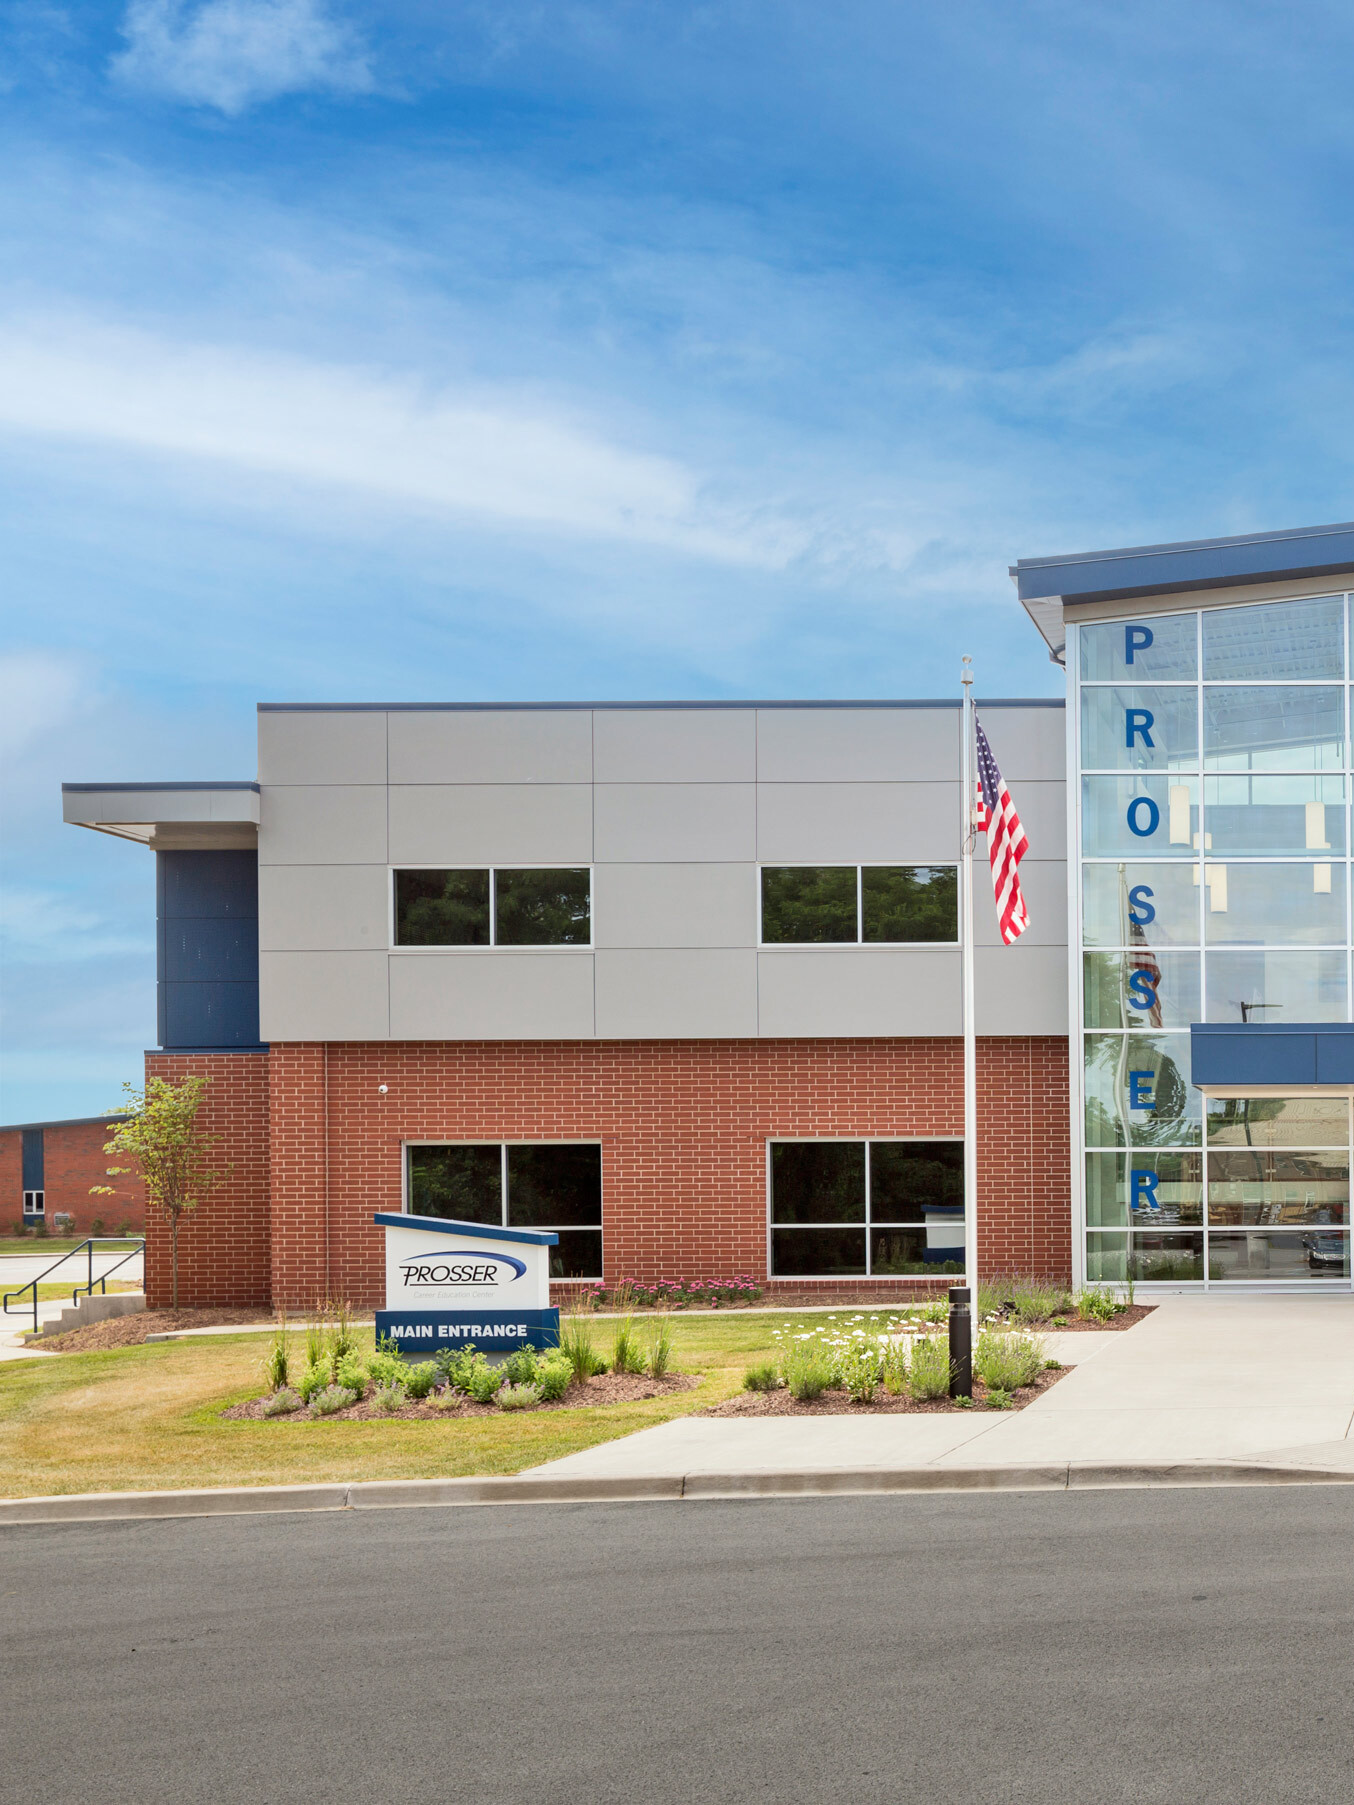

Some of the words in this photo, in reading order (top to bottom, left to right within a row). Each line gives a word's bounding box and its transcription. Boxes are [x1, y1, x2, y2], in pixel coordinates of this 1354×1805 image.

[1124, 625, 1160, 1209] PROSSER
[399, 1265, 498, 1286] PROSSER
[390, 1325, 433, 1338] MAIN
[438, 1324, 527, 1338] ENTRANCE
